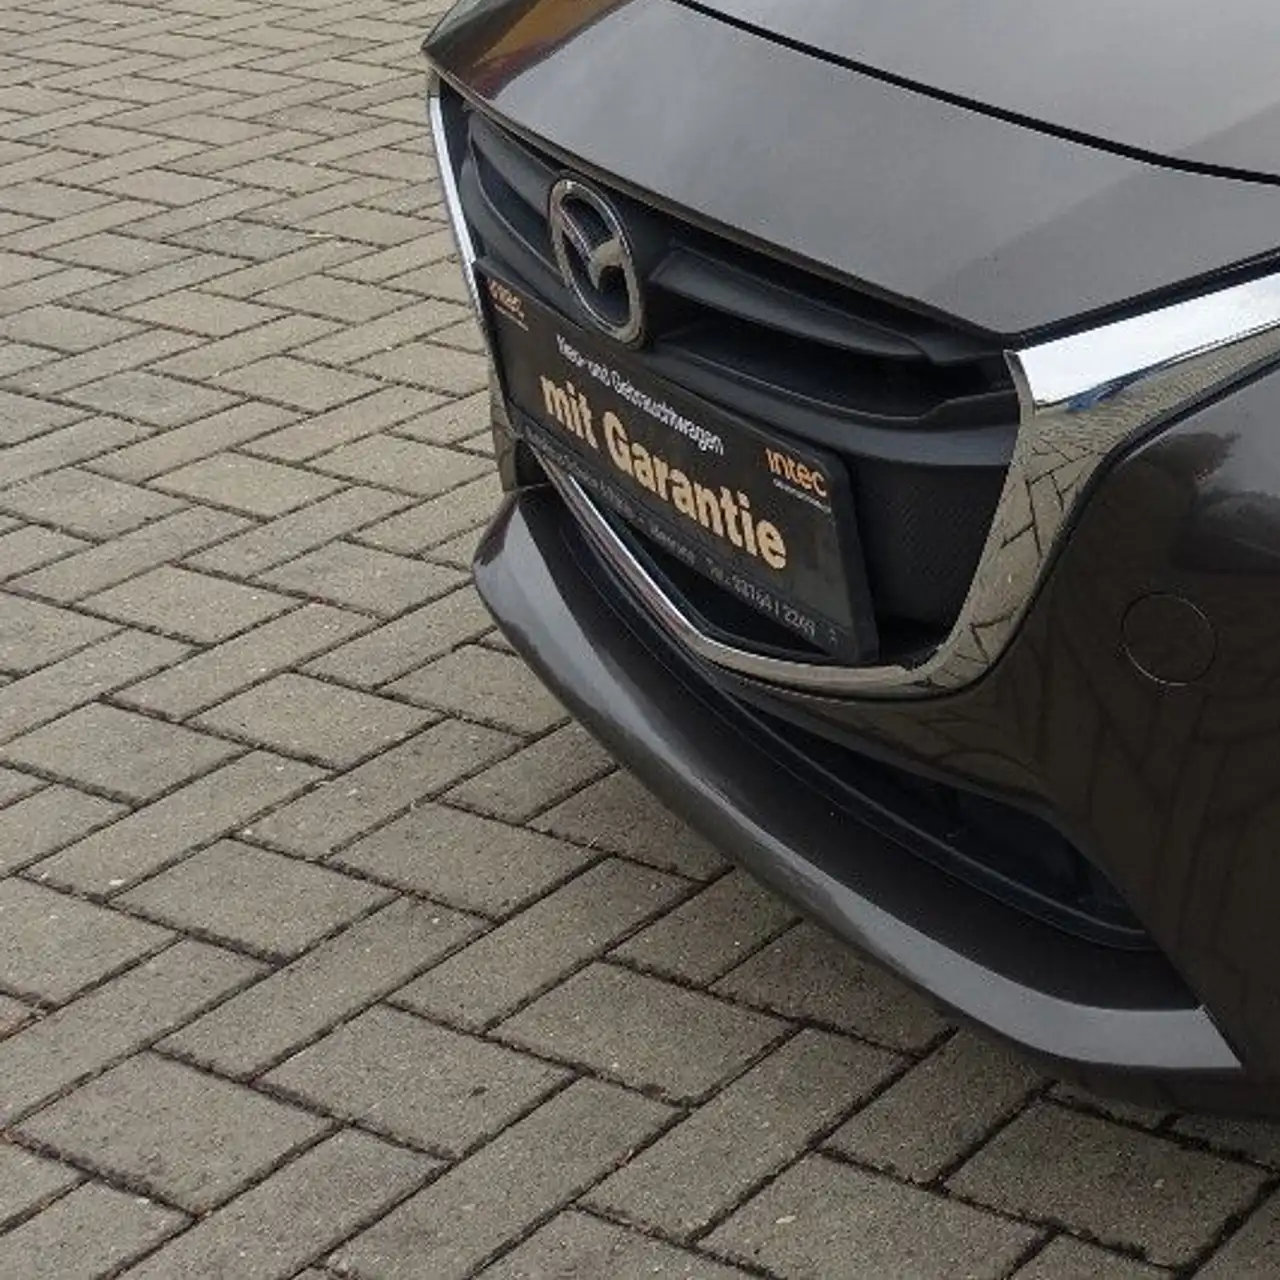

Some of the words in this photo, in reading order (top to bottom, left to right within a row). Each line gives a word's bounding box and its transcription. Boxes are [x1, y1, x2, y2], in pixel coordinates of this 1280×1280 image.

[540, 375, 599, 450] mit
[602, 411, 787, 569] Garantie
[765, 447, 827, 497] intec
